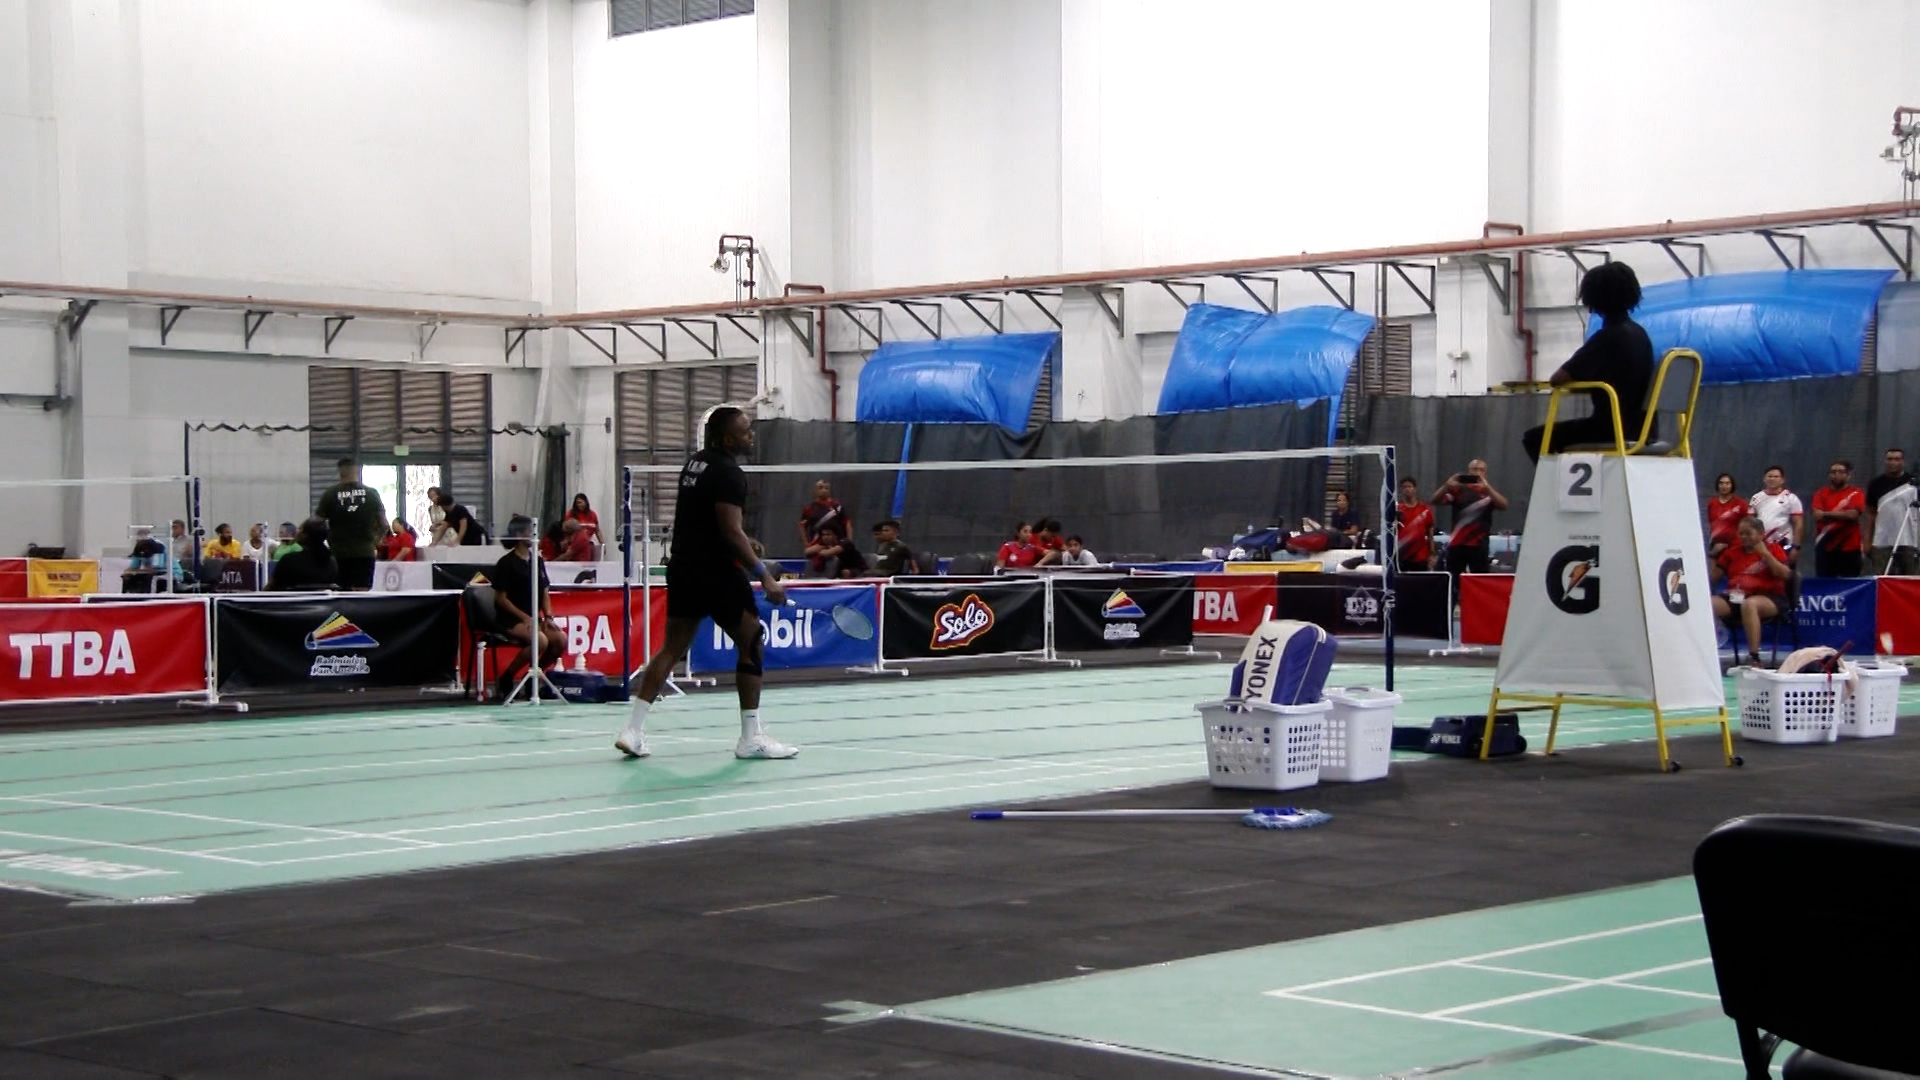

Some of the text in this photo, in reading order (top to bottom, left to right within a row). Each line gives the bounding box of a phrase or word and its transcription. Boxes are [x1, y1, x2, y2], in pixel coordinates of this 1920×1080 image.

[1568, 463, 1593, 496] 2
[219, 571, 242, 584] NTA
[1546, 545, 1600, 615] G
[1659, 557, 1690, 616] G
[1193, 591, 1239, 622] TBA
[9, 629, 136, 679] TTBA
[553, 614, 617, 654] BA
[1242, 635, 1279, 703] YONEX
